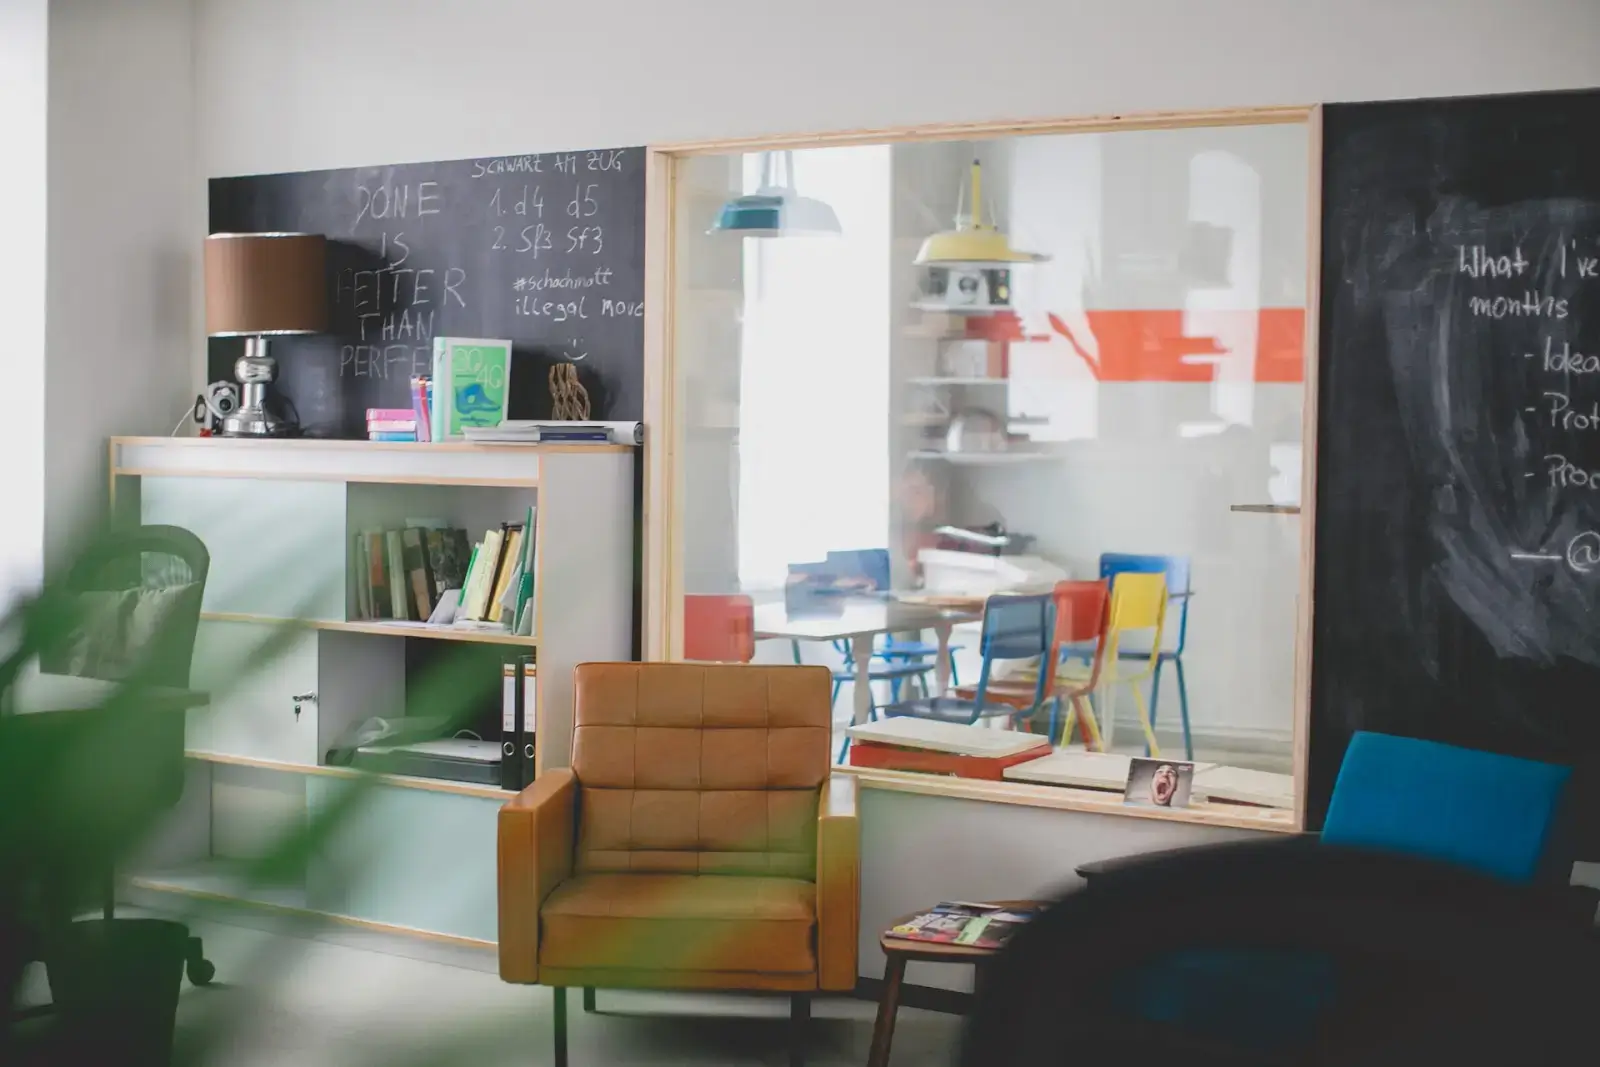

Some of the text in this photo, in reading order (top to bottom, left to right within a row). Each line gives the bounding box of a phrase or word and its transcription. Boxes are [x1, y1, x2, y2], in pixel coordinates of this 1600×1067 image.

[554, 153, 577, 175] AM
[587, 150, 625, 172] ZUG
[514, 184, 545, 219] d4
[566, 183, 599, 219] d5
[380, 232, 410, 268] IS
[1459, 238, 1599, 279] What I've
[515, 295, 588, 321] illegal
[1469, 289, 1569, 319] months
[358, 308, 435, 341] THAN
[339, 344, 434, 380] PERFE
